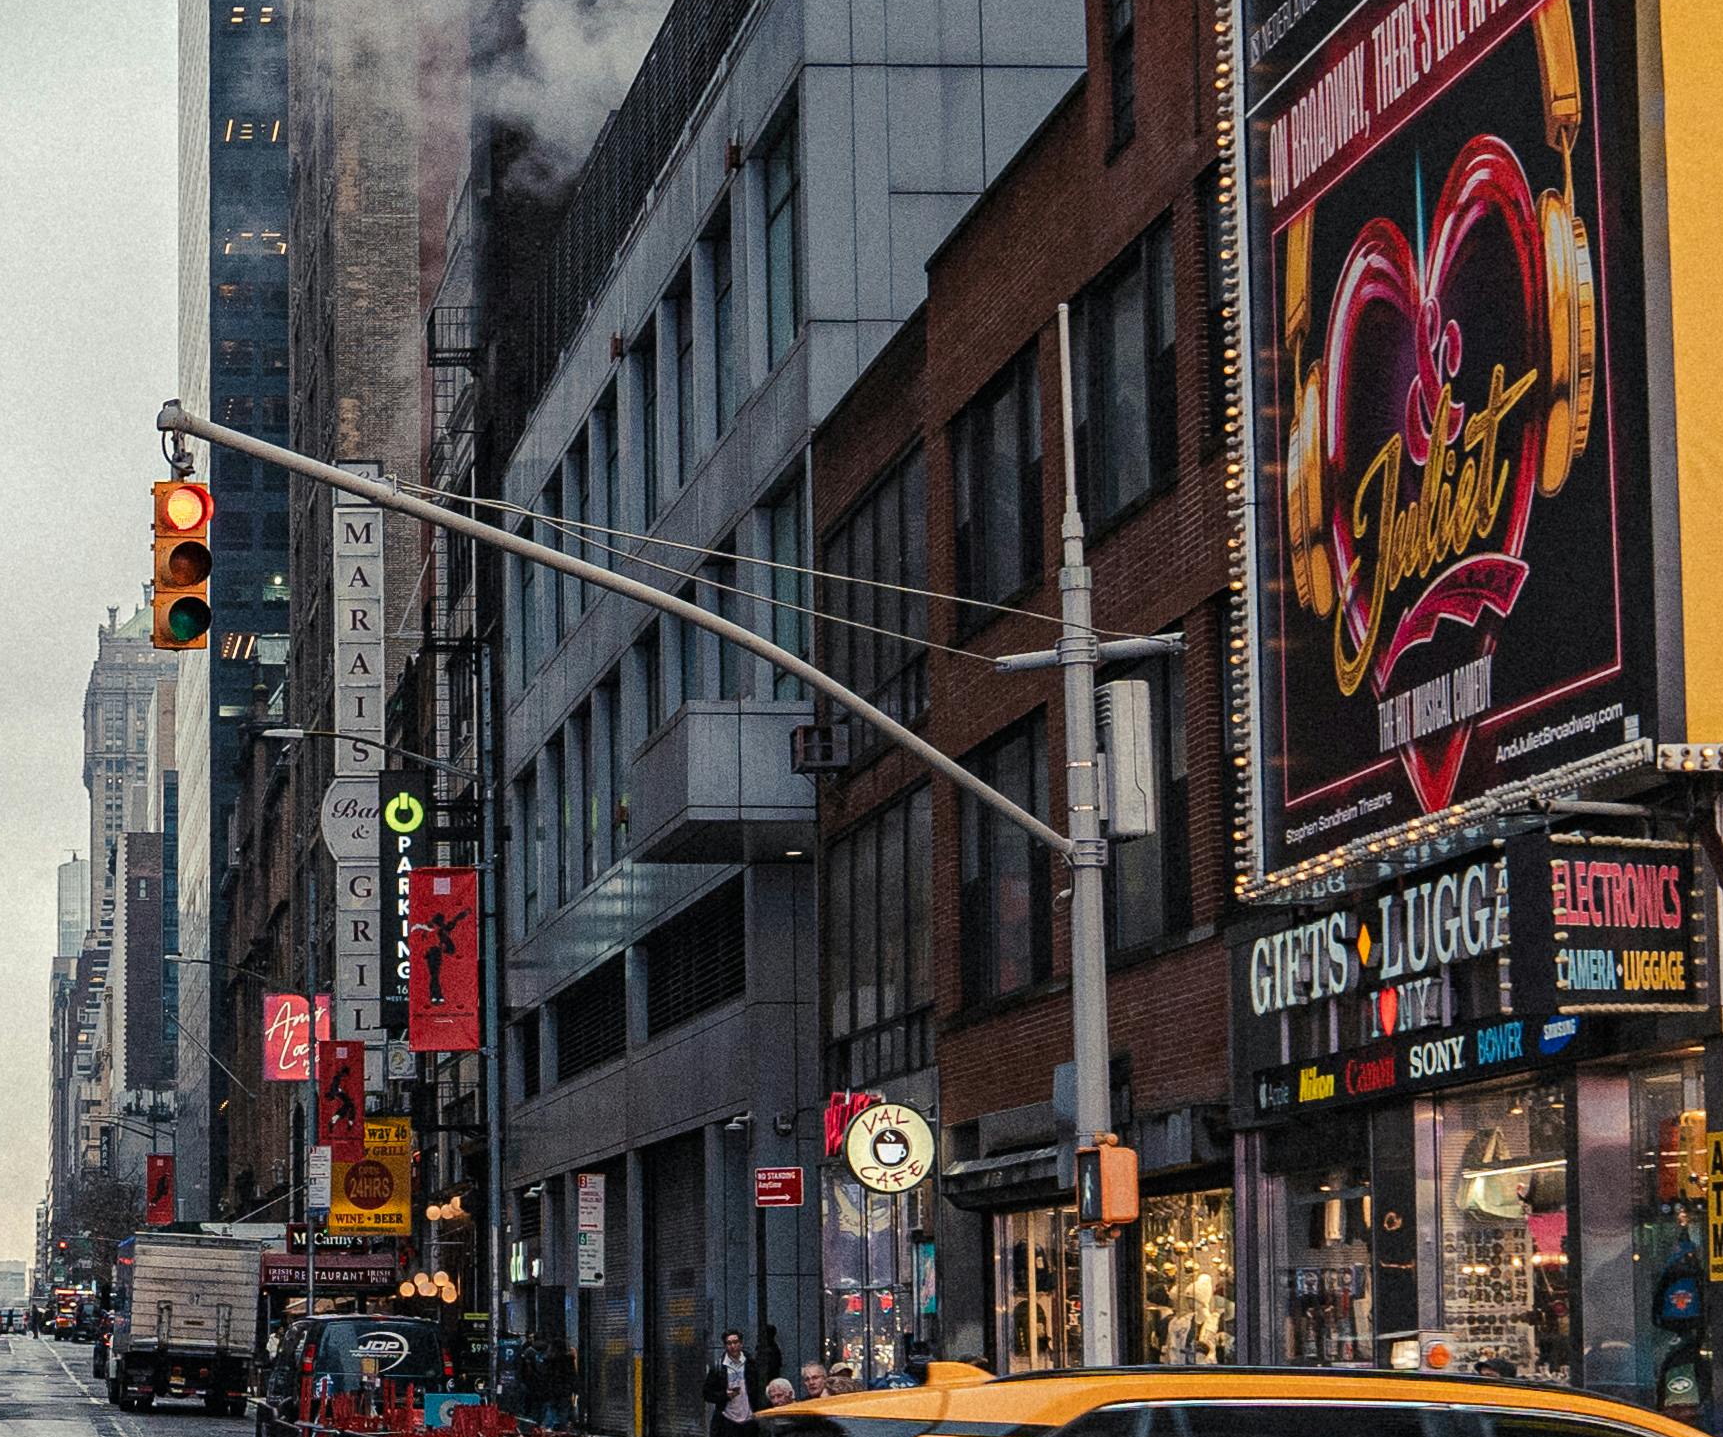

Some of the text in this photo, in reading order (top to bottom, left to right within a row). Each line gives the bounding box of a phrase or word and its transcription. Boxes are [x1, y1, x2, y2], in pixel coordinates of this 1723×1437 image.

[1270, 113, 1290, 209] ON
[1291, 40, 1371, 191] BROADWAY,
[1334, 363, 1539, 697] Juliet
[343, 521, 374, 763] MARAIS
[1378, 654, 1493, 753] THE HIT MUSICAL COMEDY
[1495, 701, 1624, 765] AndJulietBroadway.com
[351, 824, 370, 840] &
[1285, 791, 1393, 845] Stephen Sondheim Theatre
[396, 835, 412, 980] PARKING
[1553, 860, 1682, 930] ELECTRONICS
[348, 875, 374, 1081] GRIL
[1250, 911, 1349, 1017] GIFTS
[1557, 949, 1687, 992] CAMERA LUGGAGE
[1397, 977, 1432, 1032] NY
[1298, 1066, 1335, 1103] Nikon
[1345, 1057, 1397, 1095] Canon
[1408, 1035, 1466, 1079] SONY
[1476, 1019, 1524, 1065] BOWER
[1542, 1017, 1577, 1042] SAMSUNG
[861, 1107, 910, 1136] VAL
[349, 1177, 391, 1199] 24HRS
[859, 1159, 925, 1190] CAFE
[335, 1213, 404, 1225] WINE BEER
[294, 1270, 366, 1283] RETAURANT
[358, 1339, 401, 1352] JDP
